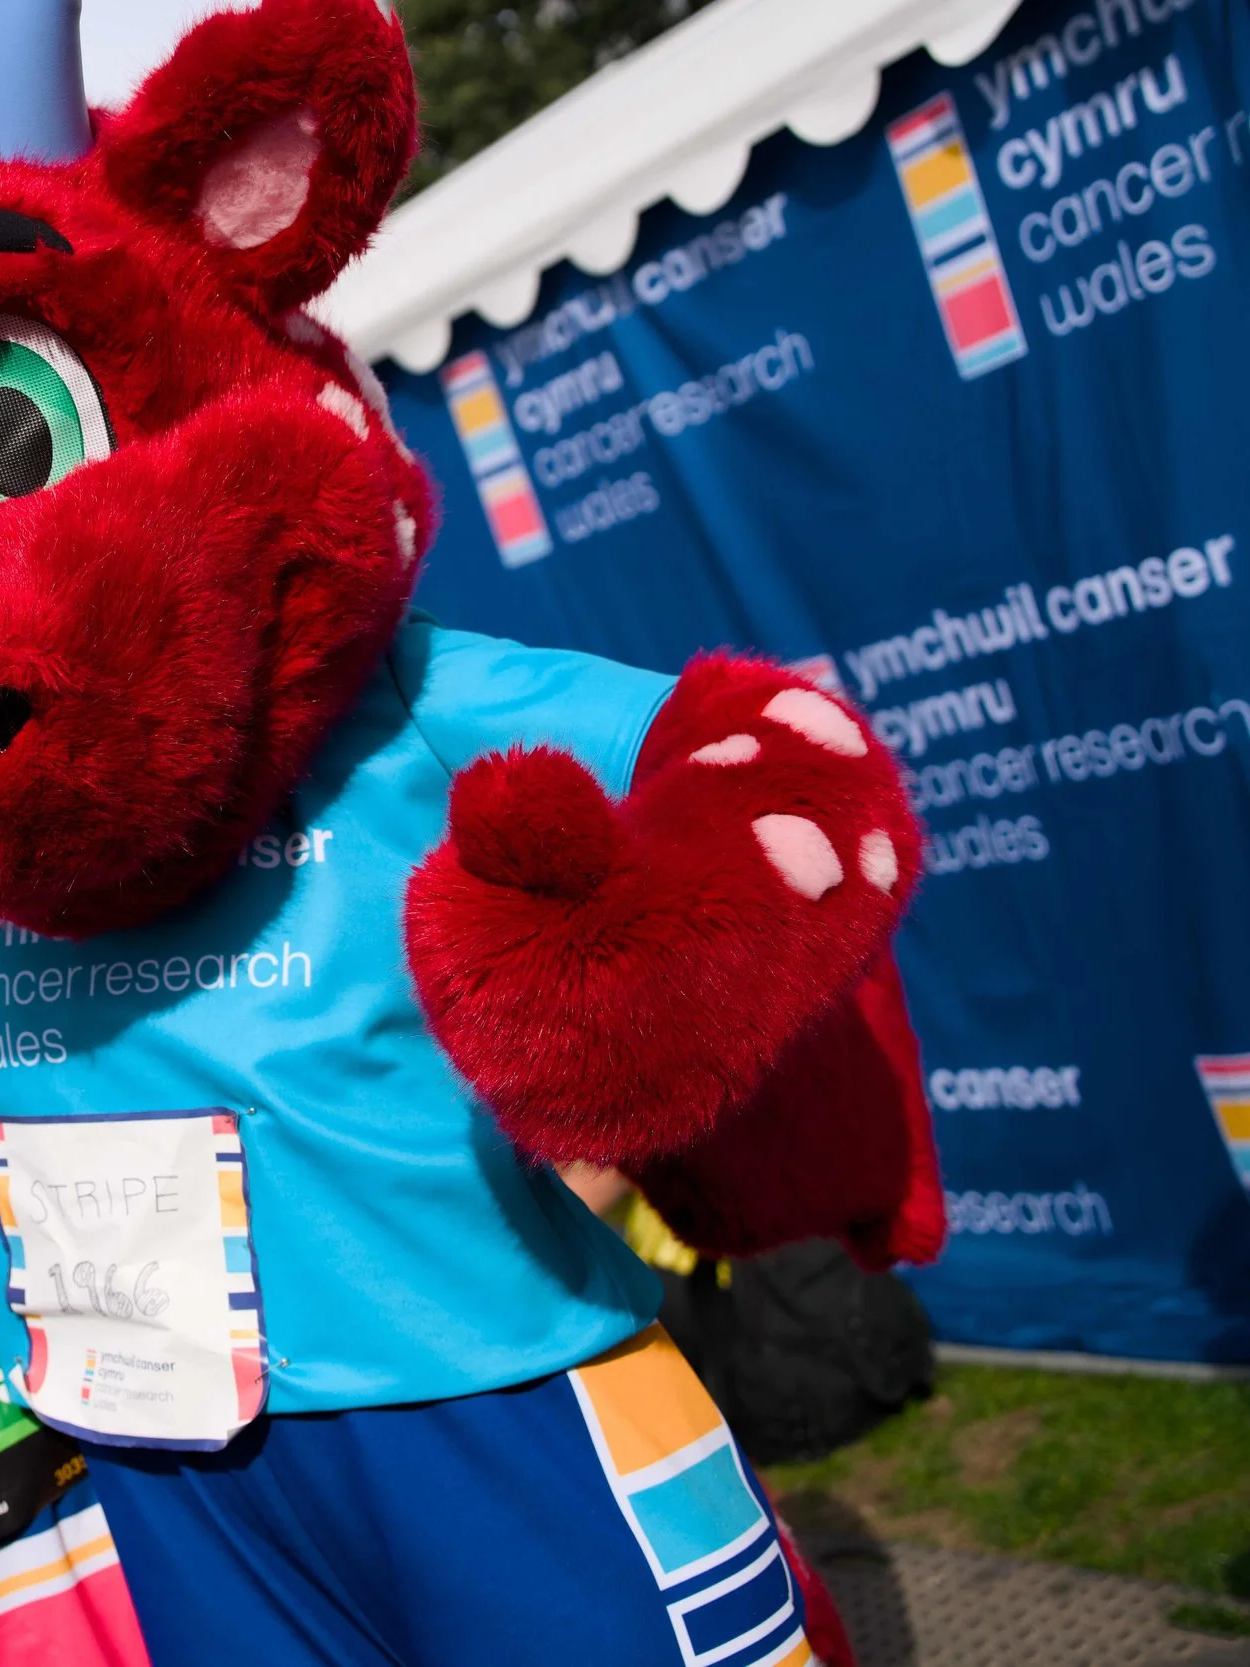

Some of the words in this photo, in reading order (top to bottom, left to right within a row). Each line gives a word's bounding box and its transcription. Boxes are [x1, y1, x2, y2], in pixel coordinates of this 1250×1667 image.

[997, 54, 1187, 189] cymru
[1019, 126, 1215, 263] cancer
[633, 192, 789, 304] canser
[1040, 223, 1217, 336] wales
[513, 350, 625, 434] cymru
[534, 401, 650, 488] cancer
[554, 470, 660, 543] wales
[845, 582, 1048, 702] ymchwil
[1047, 533, 1234, 634] canser
[871, 678, 1017, 758] cymru
[902, 745, 1039, 812] cancer
[925, 814, 1049, 875] wales
[88, 942, 311, 997] research
[930, 1066, 1081, 1111] canser
[30, 1175, 179, 1225] STRIPE
[945, 1180, 1113, 1237] esearch
[48, 1261, 170, 1321] 1966
[136, 1358, 176, 1372] canser
